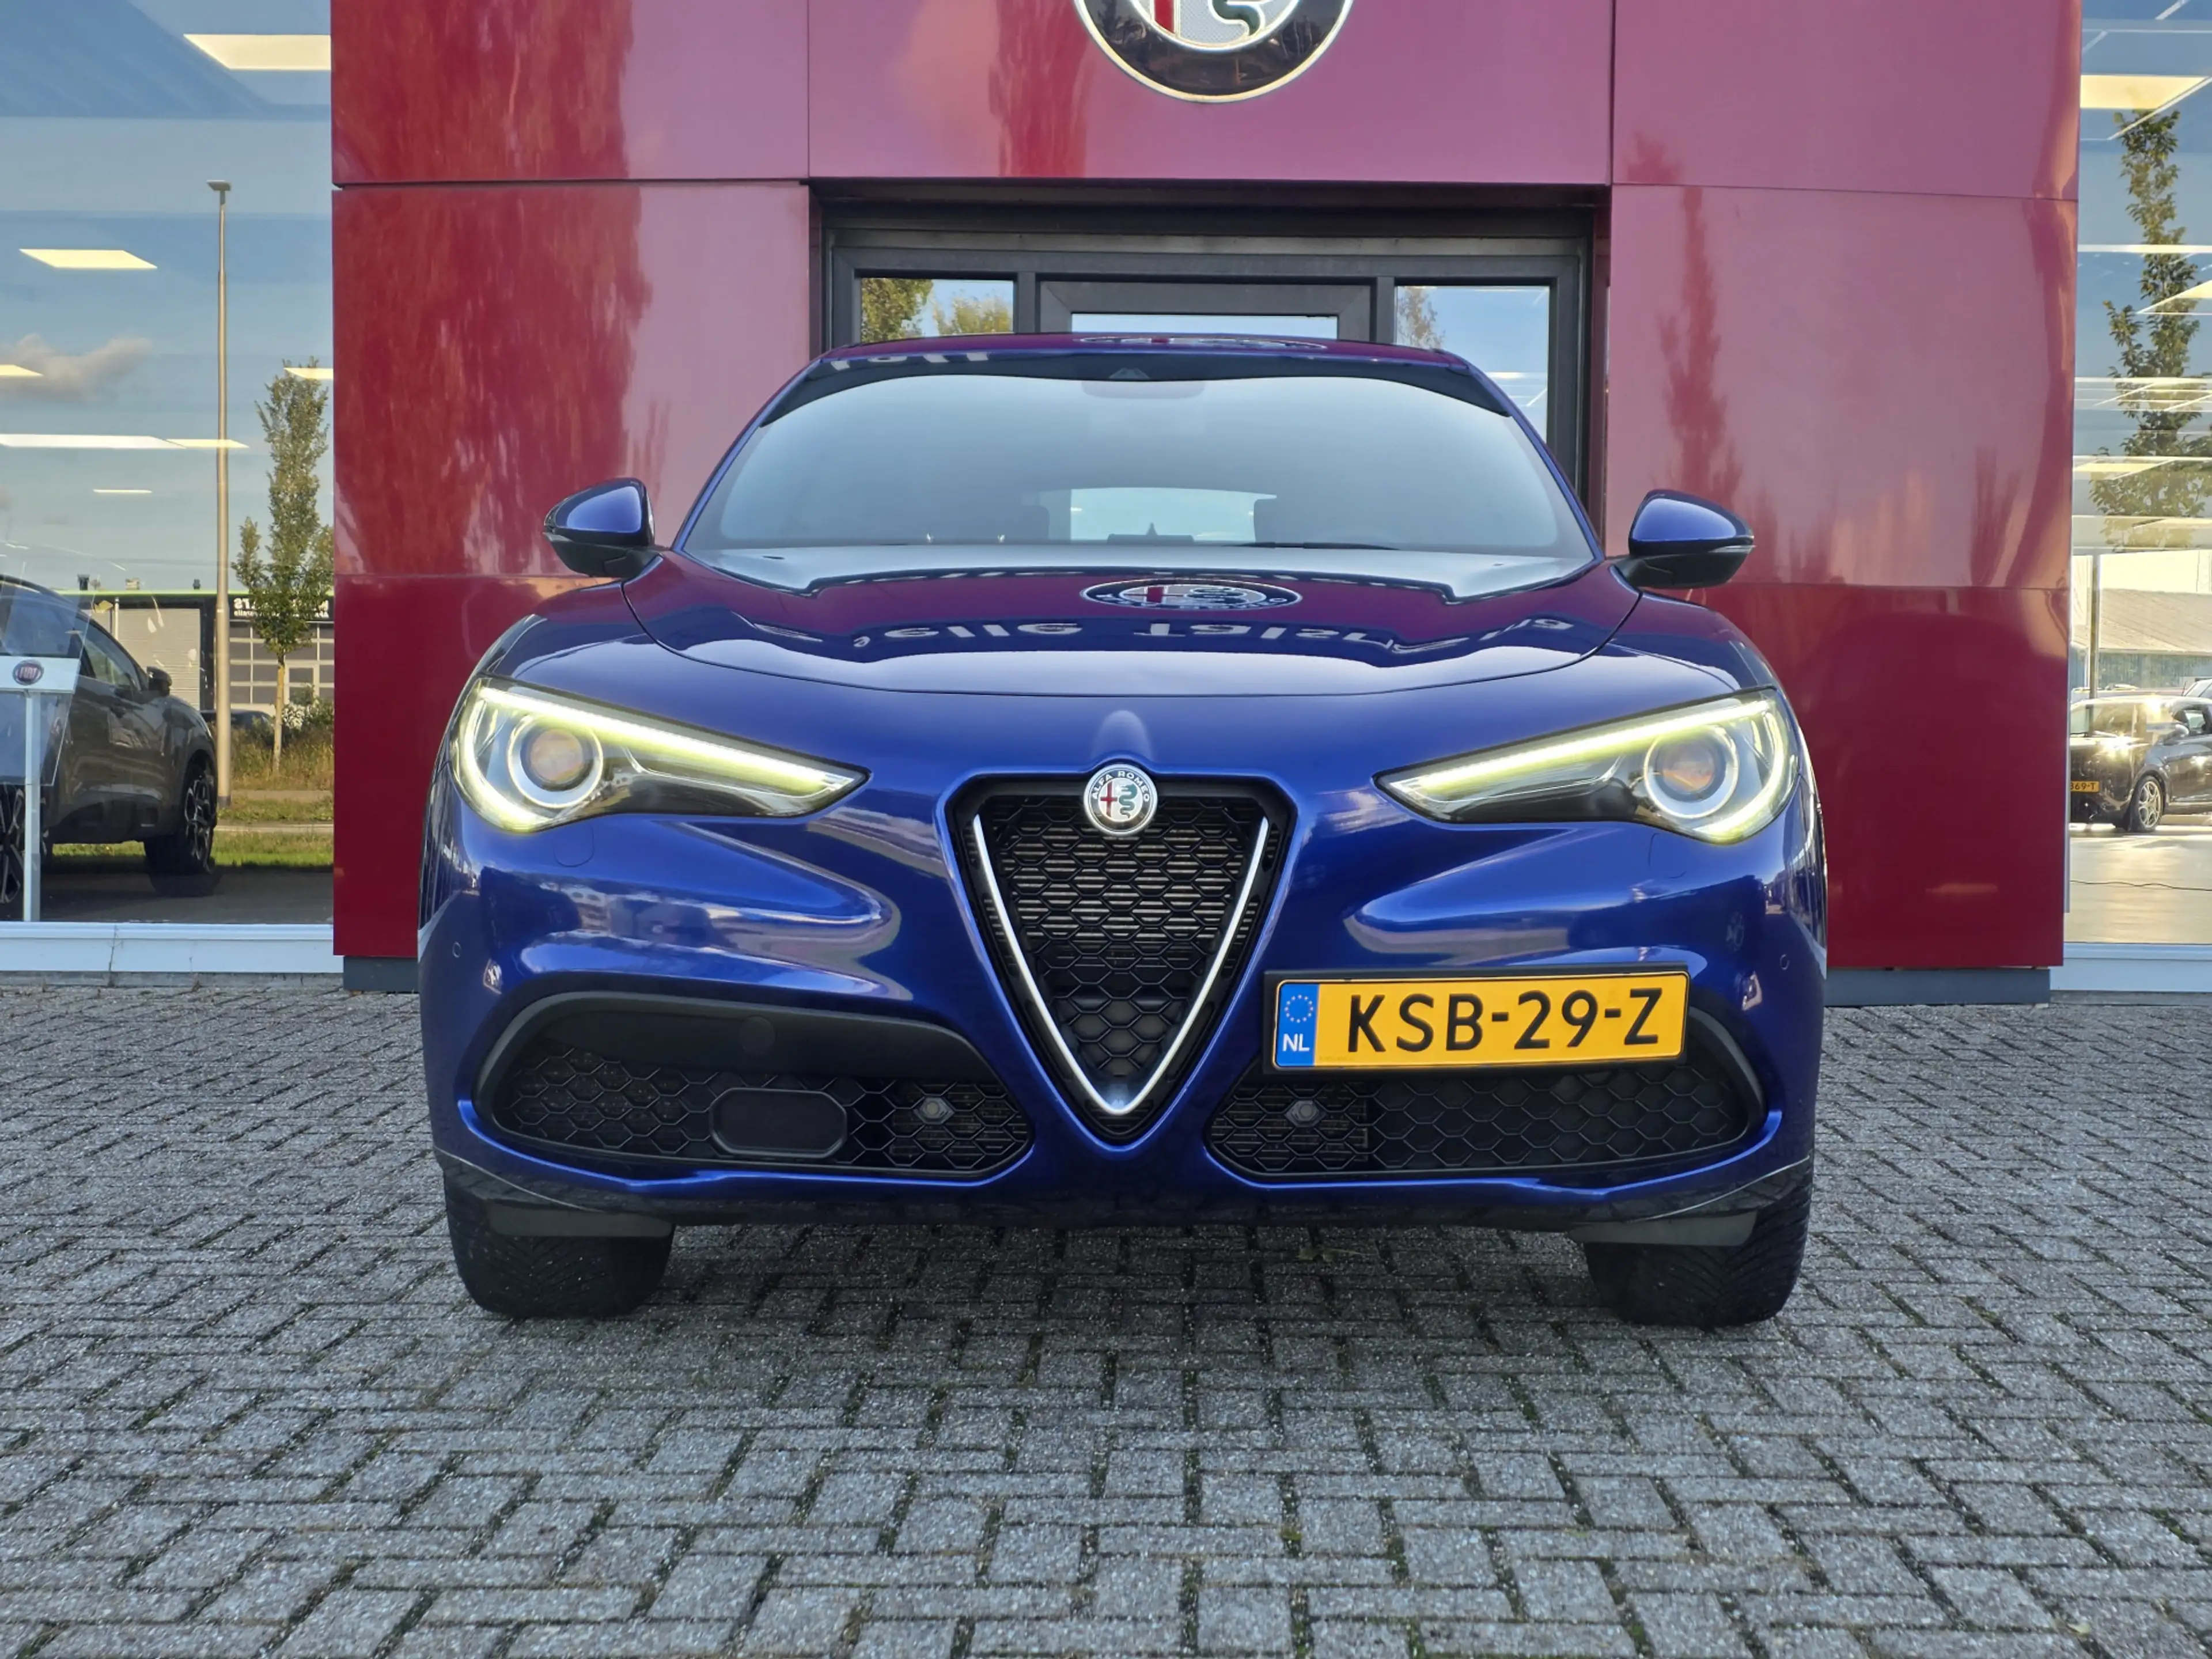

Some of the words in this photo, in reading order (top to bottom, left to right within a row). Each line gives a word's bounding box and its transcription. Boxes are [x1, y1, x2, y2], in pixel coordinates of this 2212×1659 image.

[1092, 774, 1113, 800] ALFA
[1118, 770, 1150, 802] ROMEO
[1347, 987, 1663, 1052] KSB-29-Z
[1282, 1033, 1310, 1052] NL
